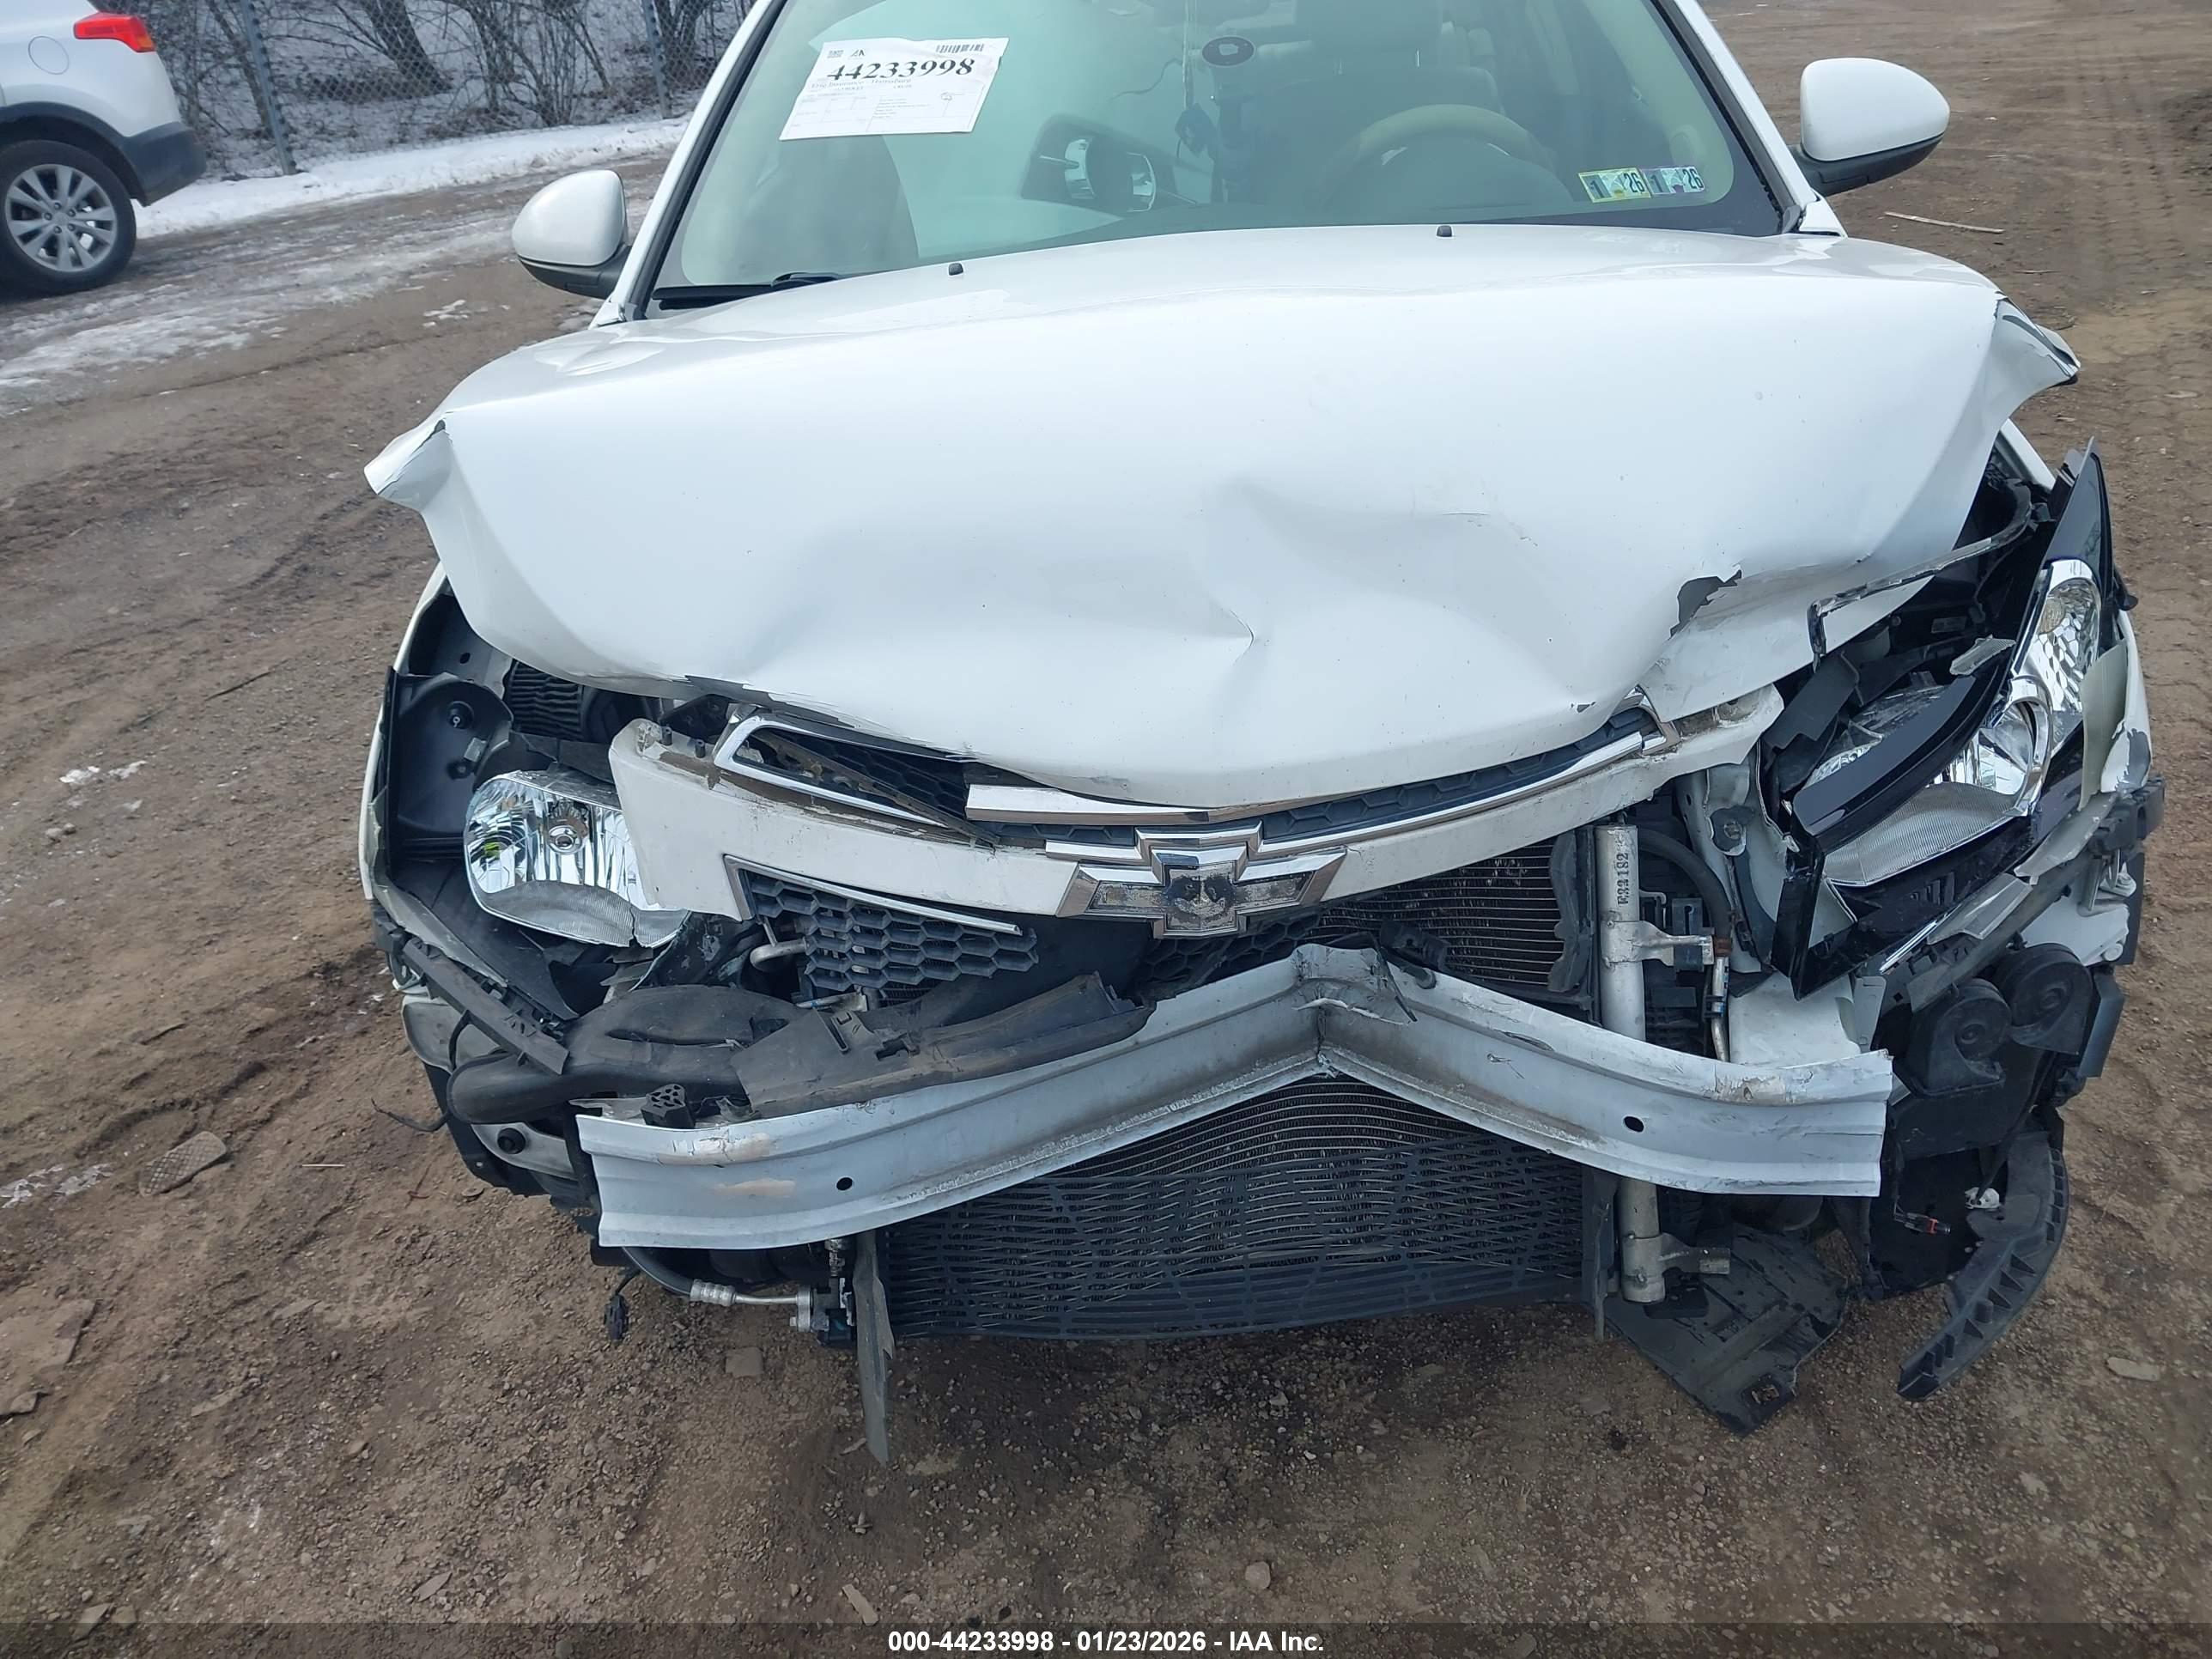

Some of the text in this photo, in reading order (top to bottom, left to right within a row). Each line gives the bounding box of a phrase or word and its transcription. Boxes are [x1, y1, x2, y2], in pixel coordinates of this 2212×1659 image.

[827, 58, 975, 82] 44233998
[1590, 173, 1645, 198] 1 26
[1650, 168, 1705, 193] 1 26
